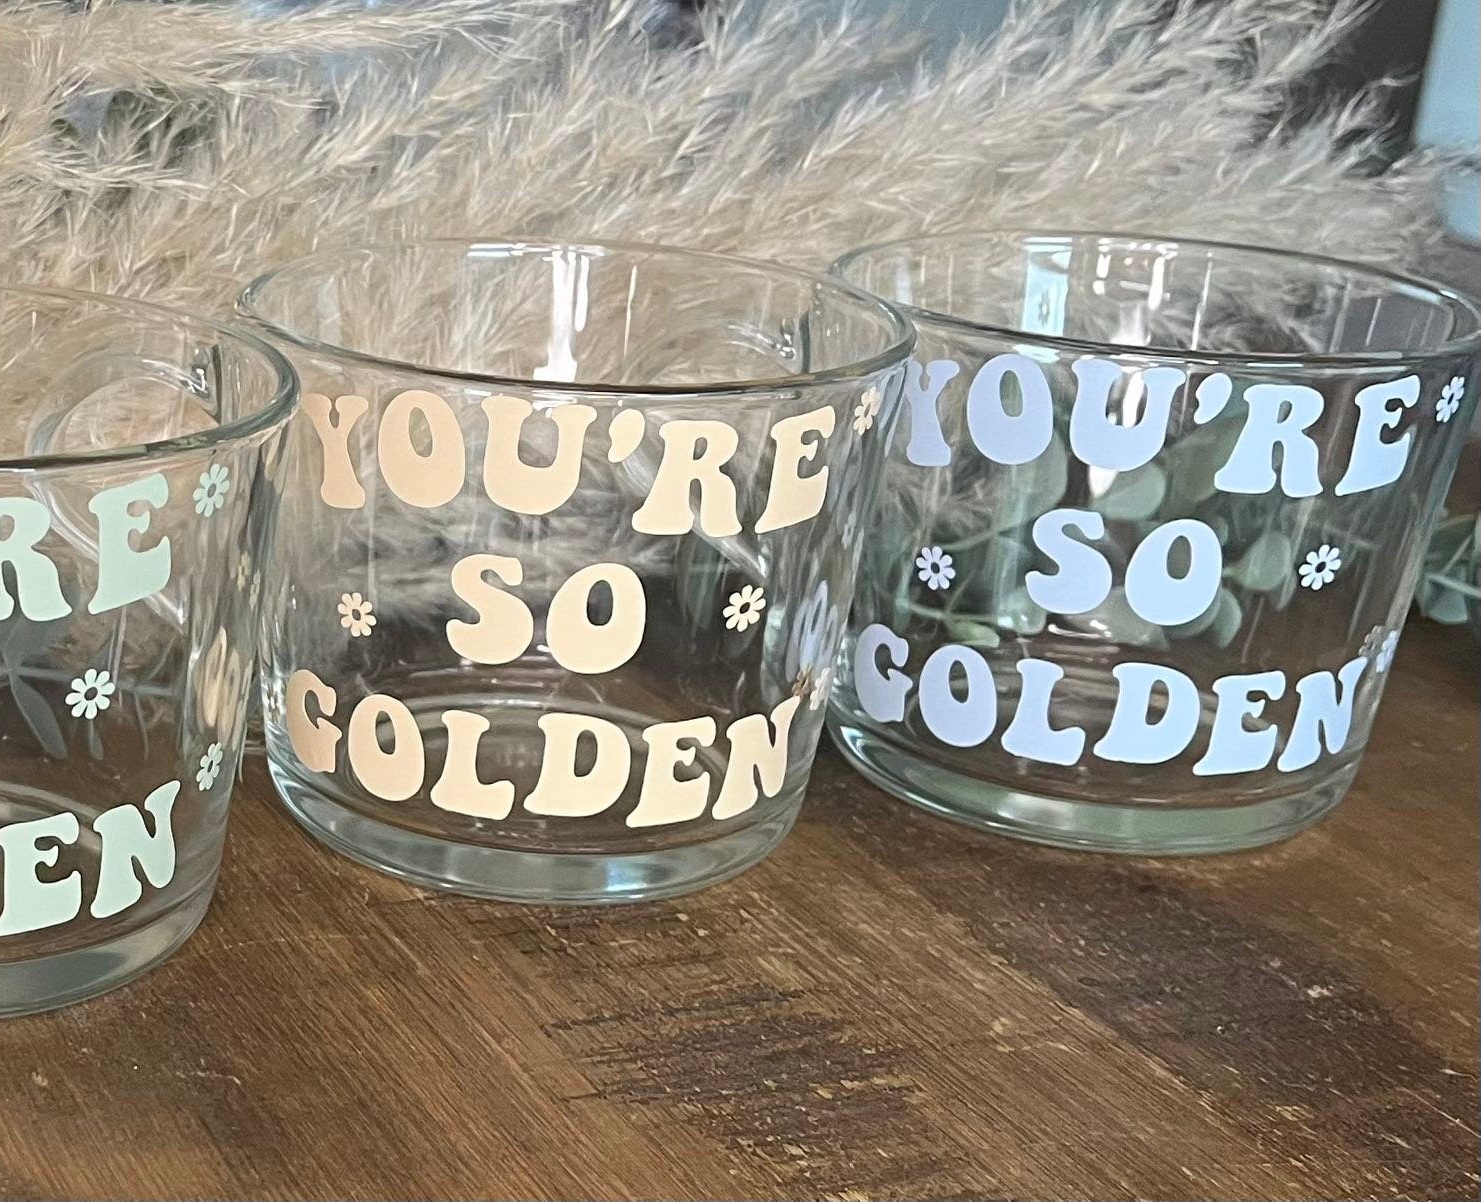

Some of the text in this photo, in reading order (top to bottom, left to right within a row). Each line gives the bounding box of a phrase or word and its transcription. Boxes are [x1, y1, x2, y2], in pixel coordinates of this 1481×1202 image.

[301, 389, 836, 537] YOU'RE
[907, 354, 1420, 498] YOU'RE
[445, 553, 647, 674] SO
[1024, 508, 1223, 626] SO
[286, 669, 801, 828] GOLDEN
[854, 623, 1369, 777] GOLDEN
